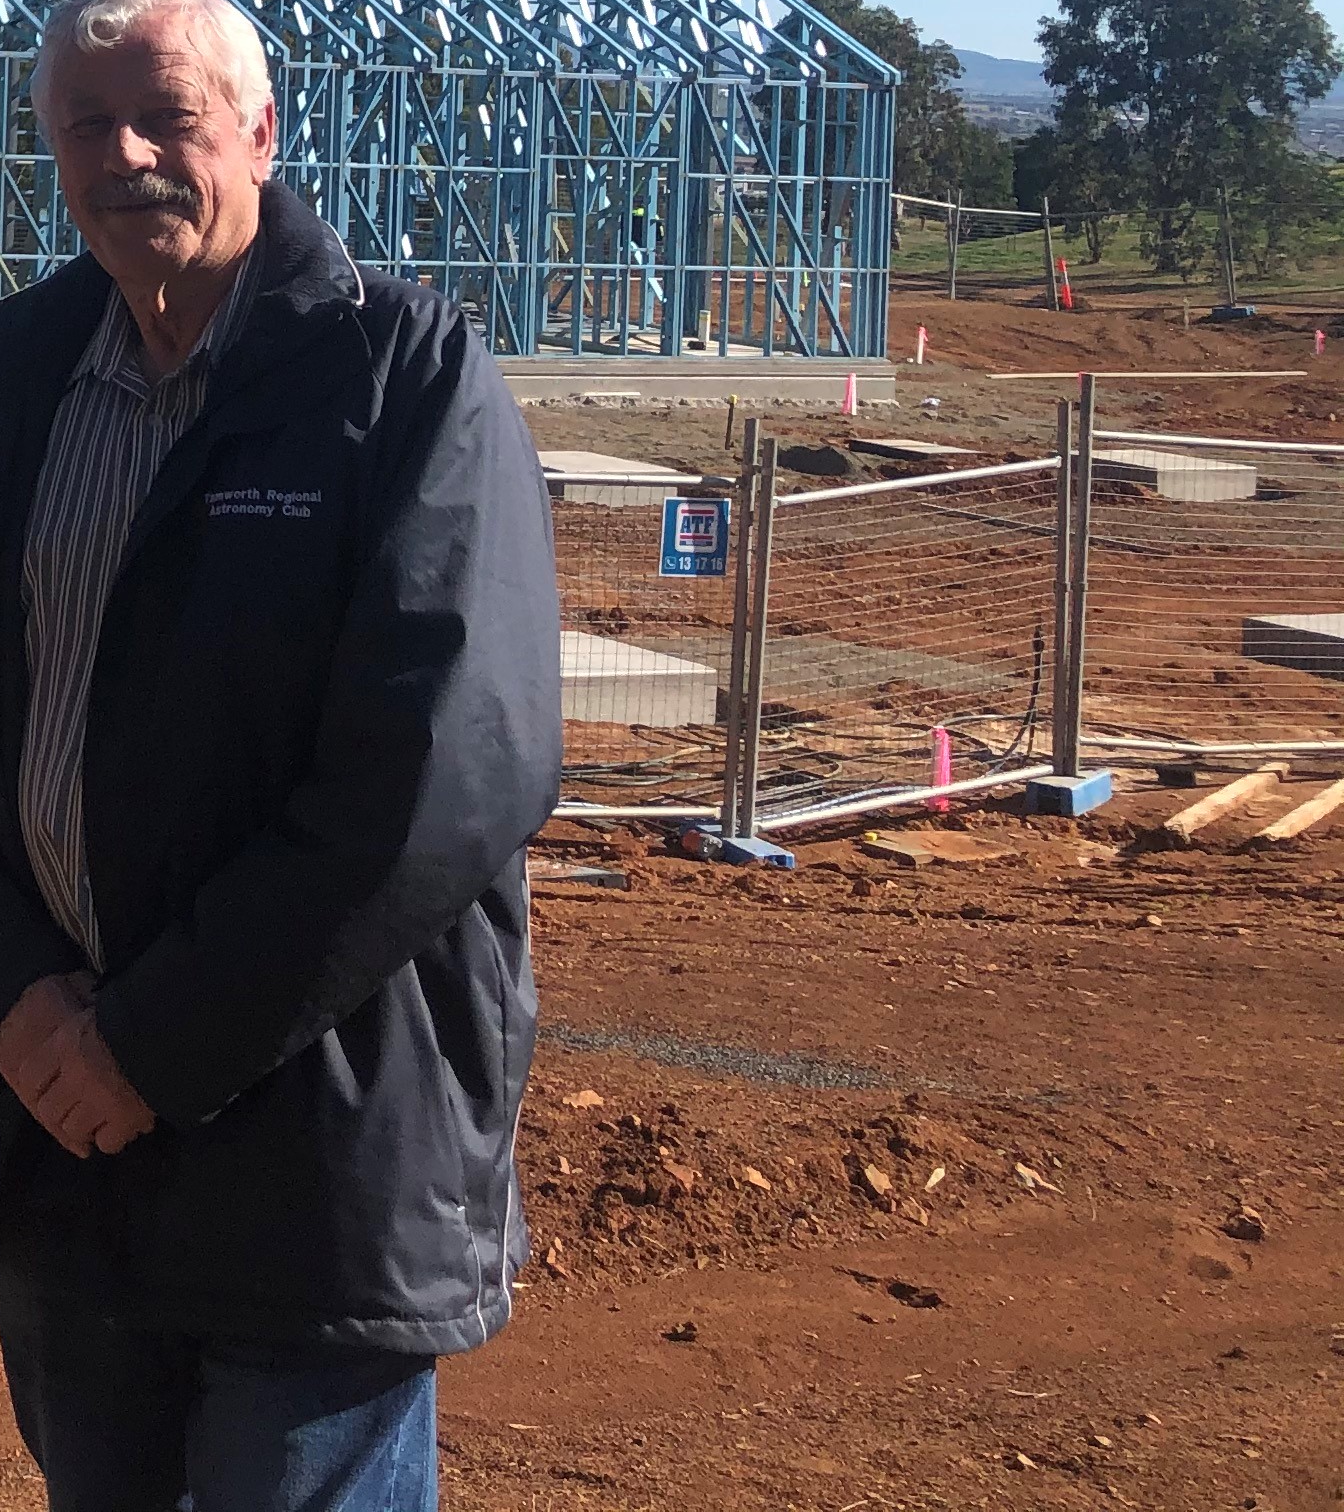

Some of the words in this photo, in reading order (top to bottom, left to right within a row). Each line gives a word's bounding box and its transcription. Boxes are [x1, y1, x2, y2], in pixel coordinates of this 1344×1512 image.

[267, 489, 322, 503] Regional
[209, 505, 274, 517] Astronomy
[283, 505, 311, 517] Club
[680, 516, 714, 533] ATF
[679, 557, 691, 570] 13
[695, 558, 708, 570] 17
[711, 558, 722, 570] 16
